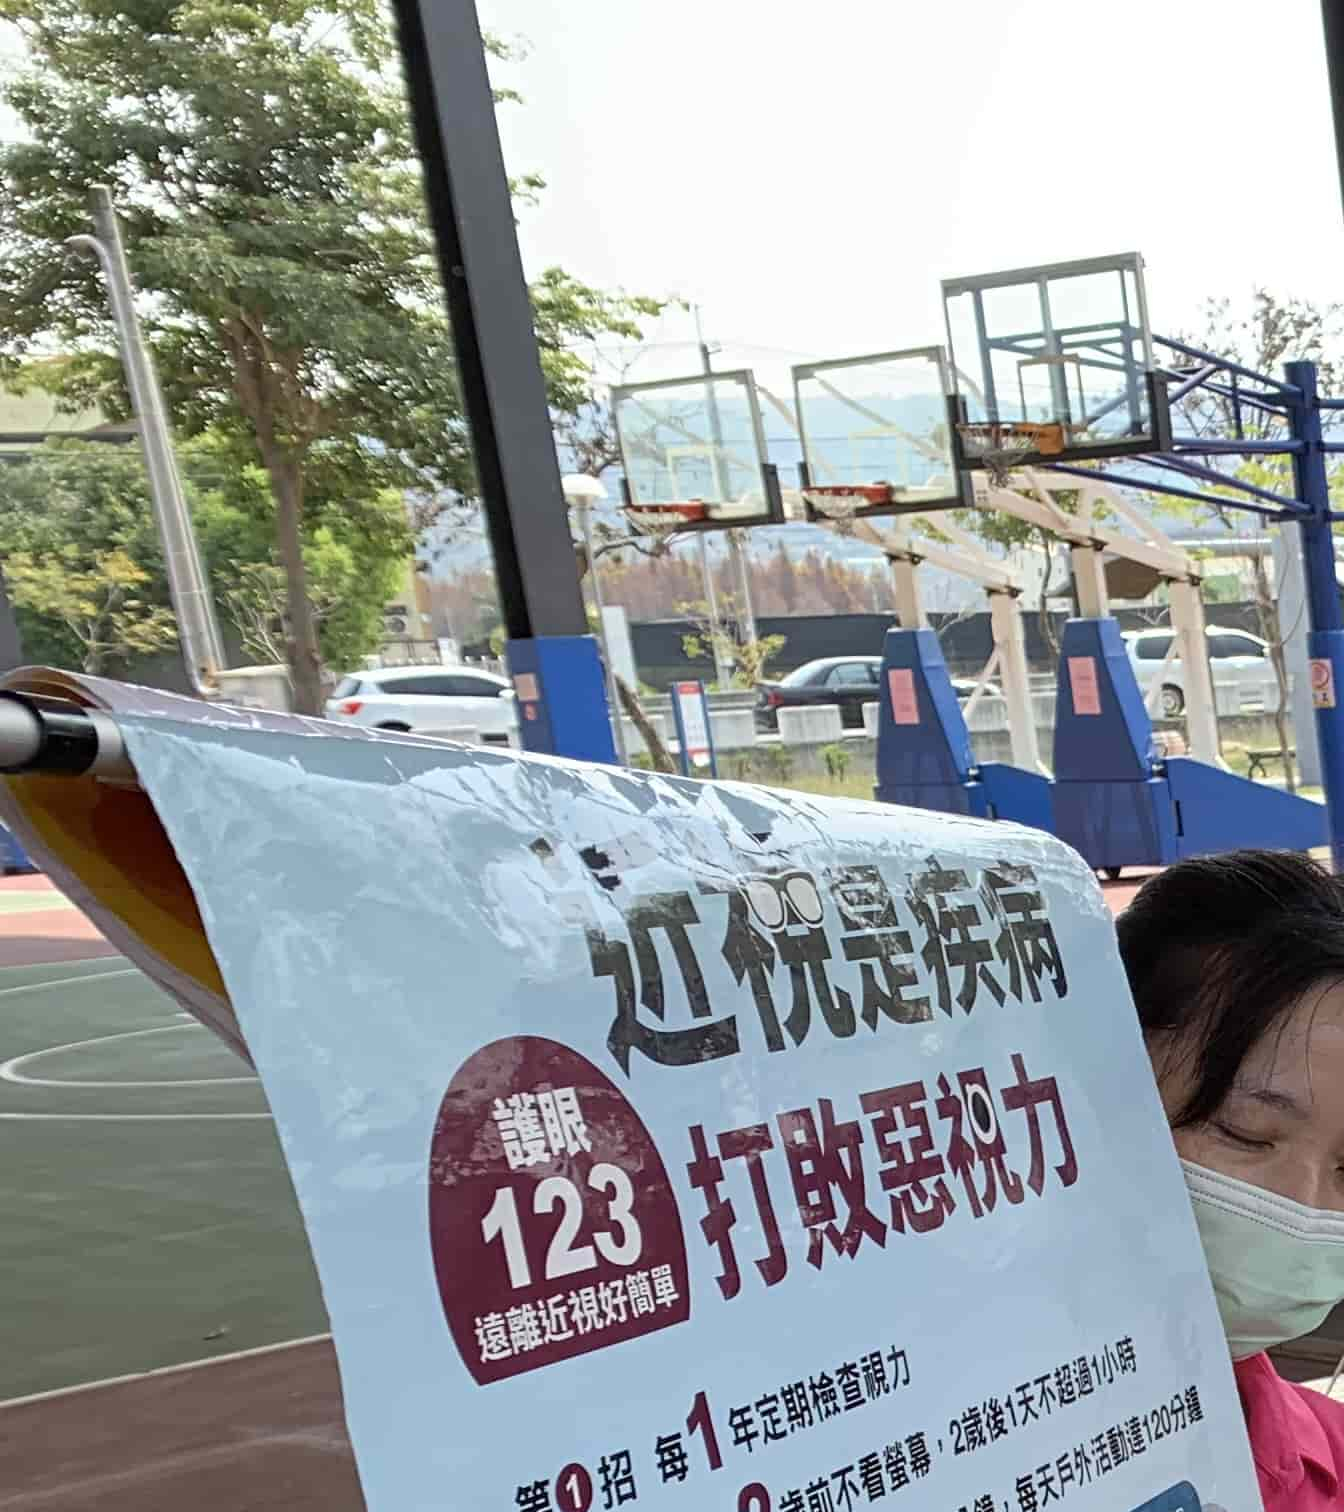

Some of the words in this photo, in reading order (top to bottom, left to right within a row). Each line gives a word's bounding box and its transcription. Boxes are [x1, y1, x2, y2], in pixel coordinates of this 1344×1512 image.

[584, 850, 1069, 1079] 近視是疾病
[492, 1086, 592, 1170] 護眼
[686, 1052, 1080, 1301] 打敗惡視力
[481, 1162, 643, 1290] 123
[474, 1263, 680, 1363] 遠離近視好簡單
[653, 1344, 913, 1490] 每1年定期檢查視力
